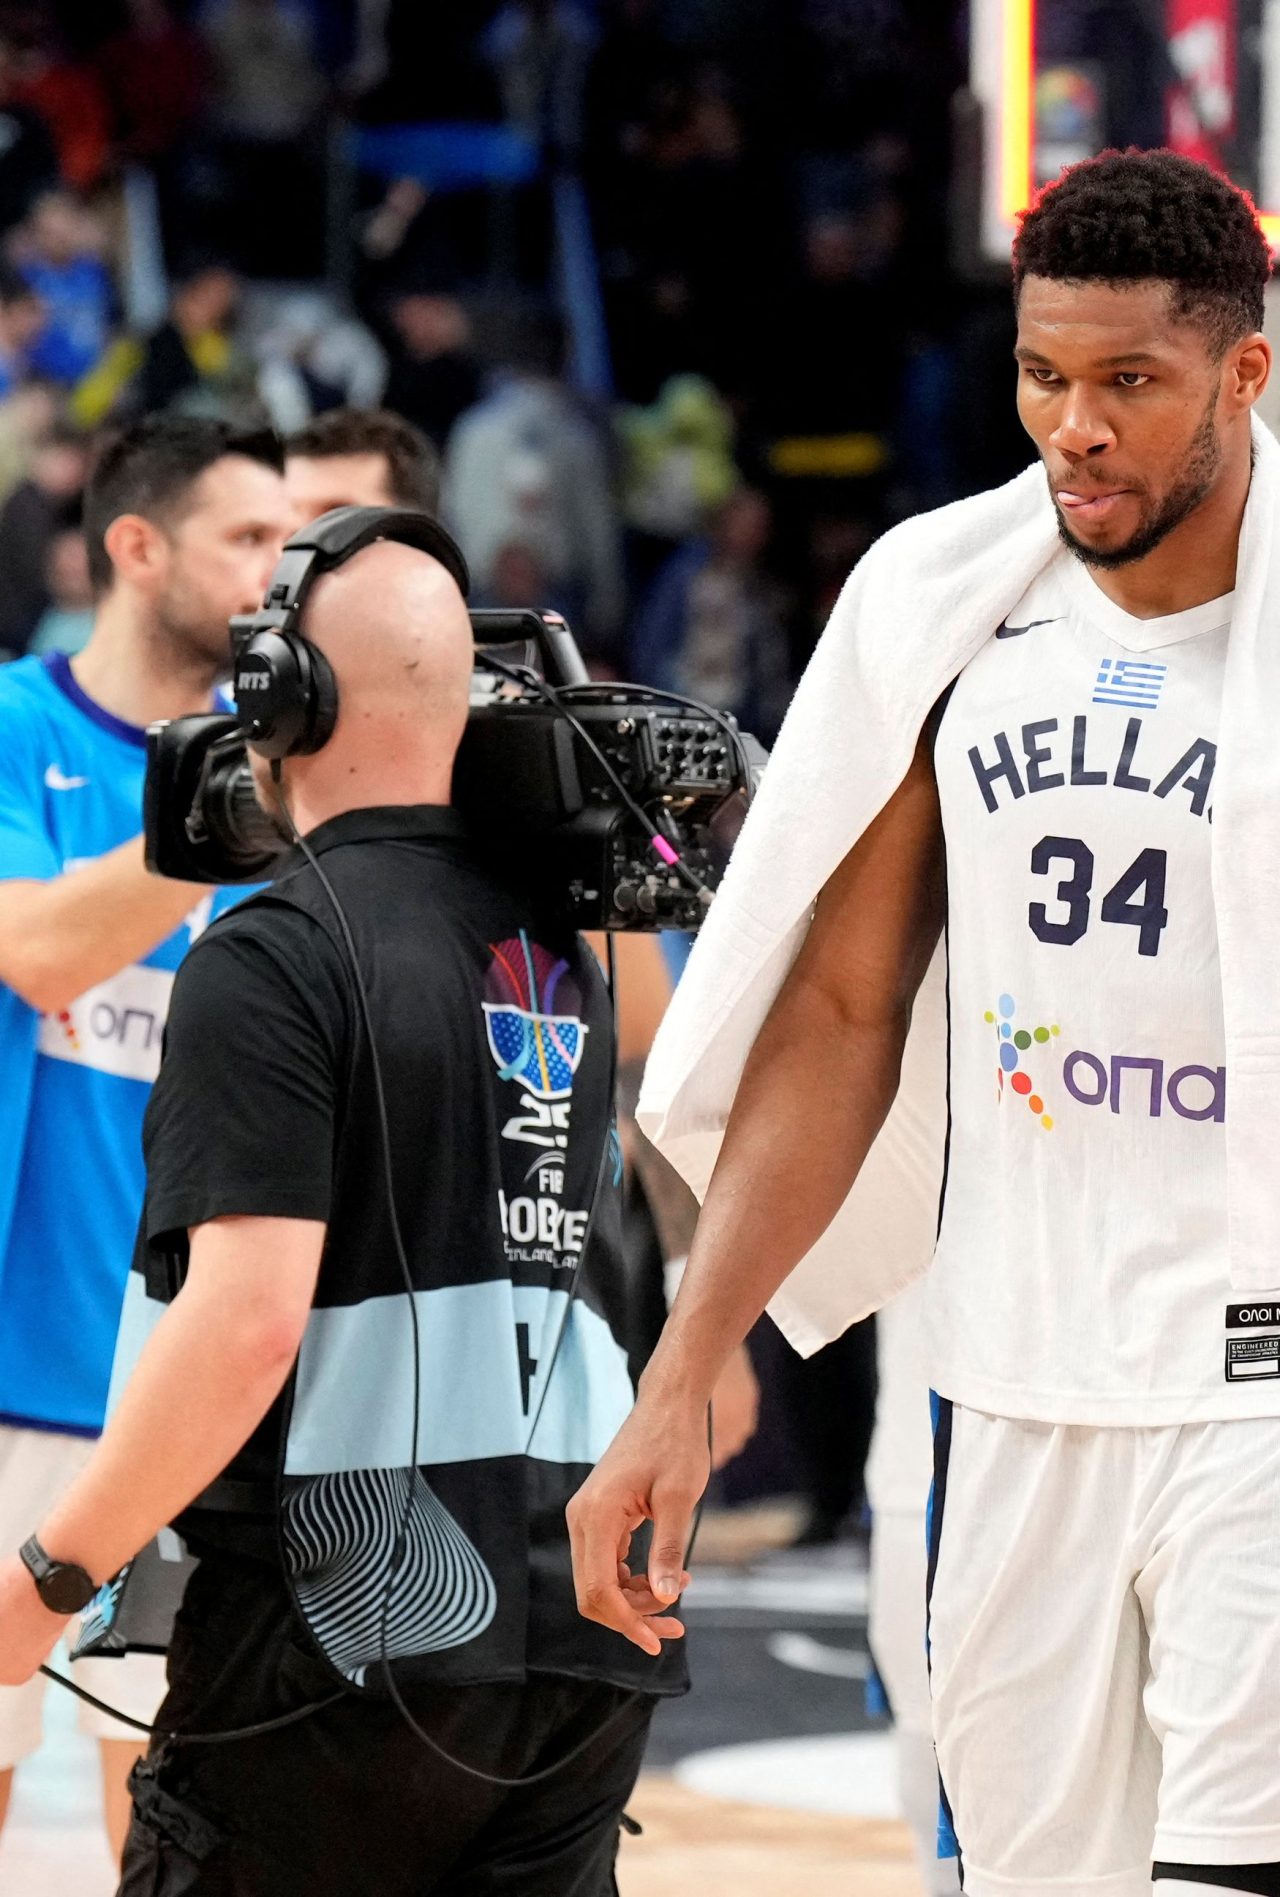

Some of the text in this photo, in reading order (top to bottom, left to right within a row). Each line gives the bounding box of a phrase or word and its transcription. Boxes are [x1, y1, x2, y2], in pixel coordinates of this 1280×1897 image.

[239, 672, 270, 690] RTS
[968, 715, 1217, 824] HELLA
[1029, 835, 1168, 956] 34
[1063, 1050, 1227, 1123] οπα
[1231, 1341, 1279, 1351] ENGINEERED
